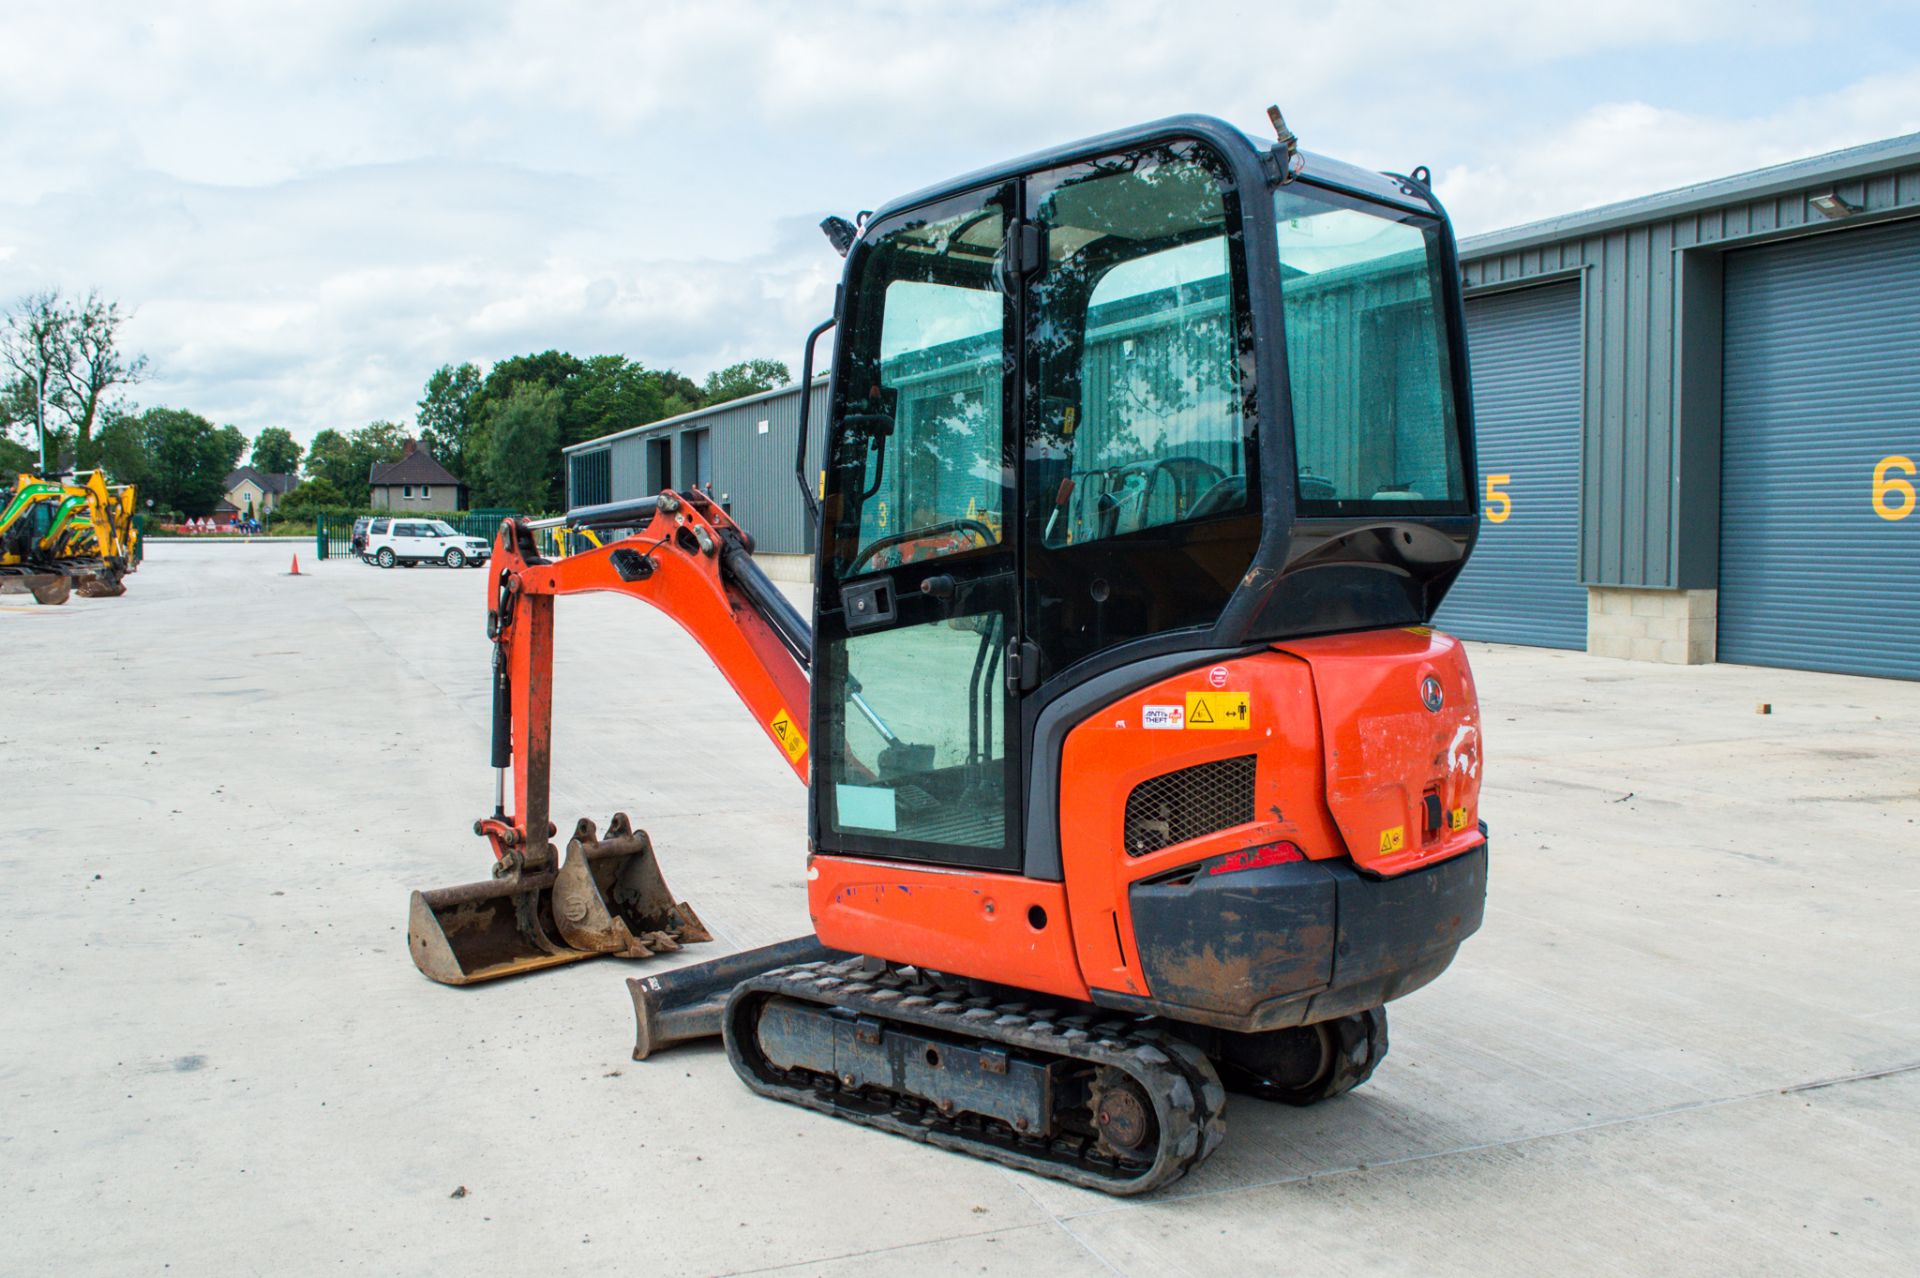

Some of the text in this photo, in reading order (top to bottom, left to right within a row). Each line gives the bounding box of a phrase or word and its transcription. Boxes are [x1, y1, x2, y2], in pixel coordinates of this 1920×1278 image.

[1485, 474, 1511, 524] 5
[1872, 455, 1917, 521] 6
[878, 502, 887, 528] 3
[966, 496, 977, 519] 4
